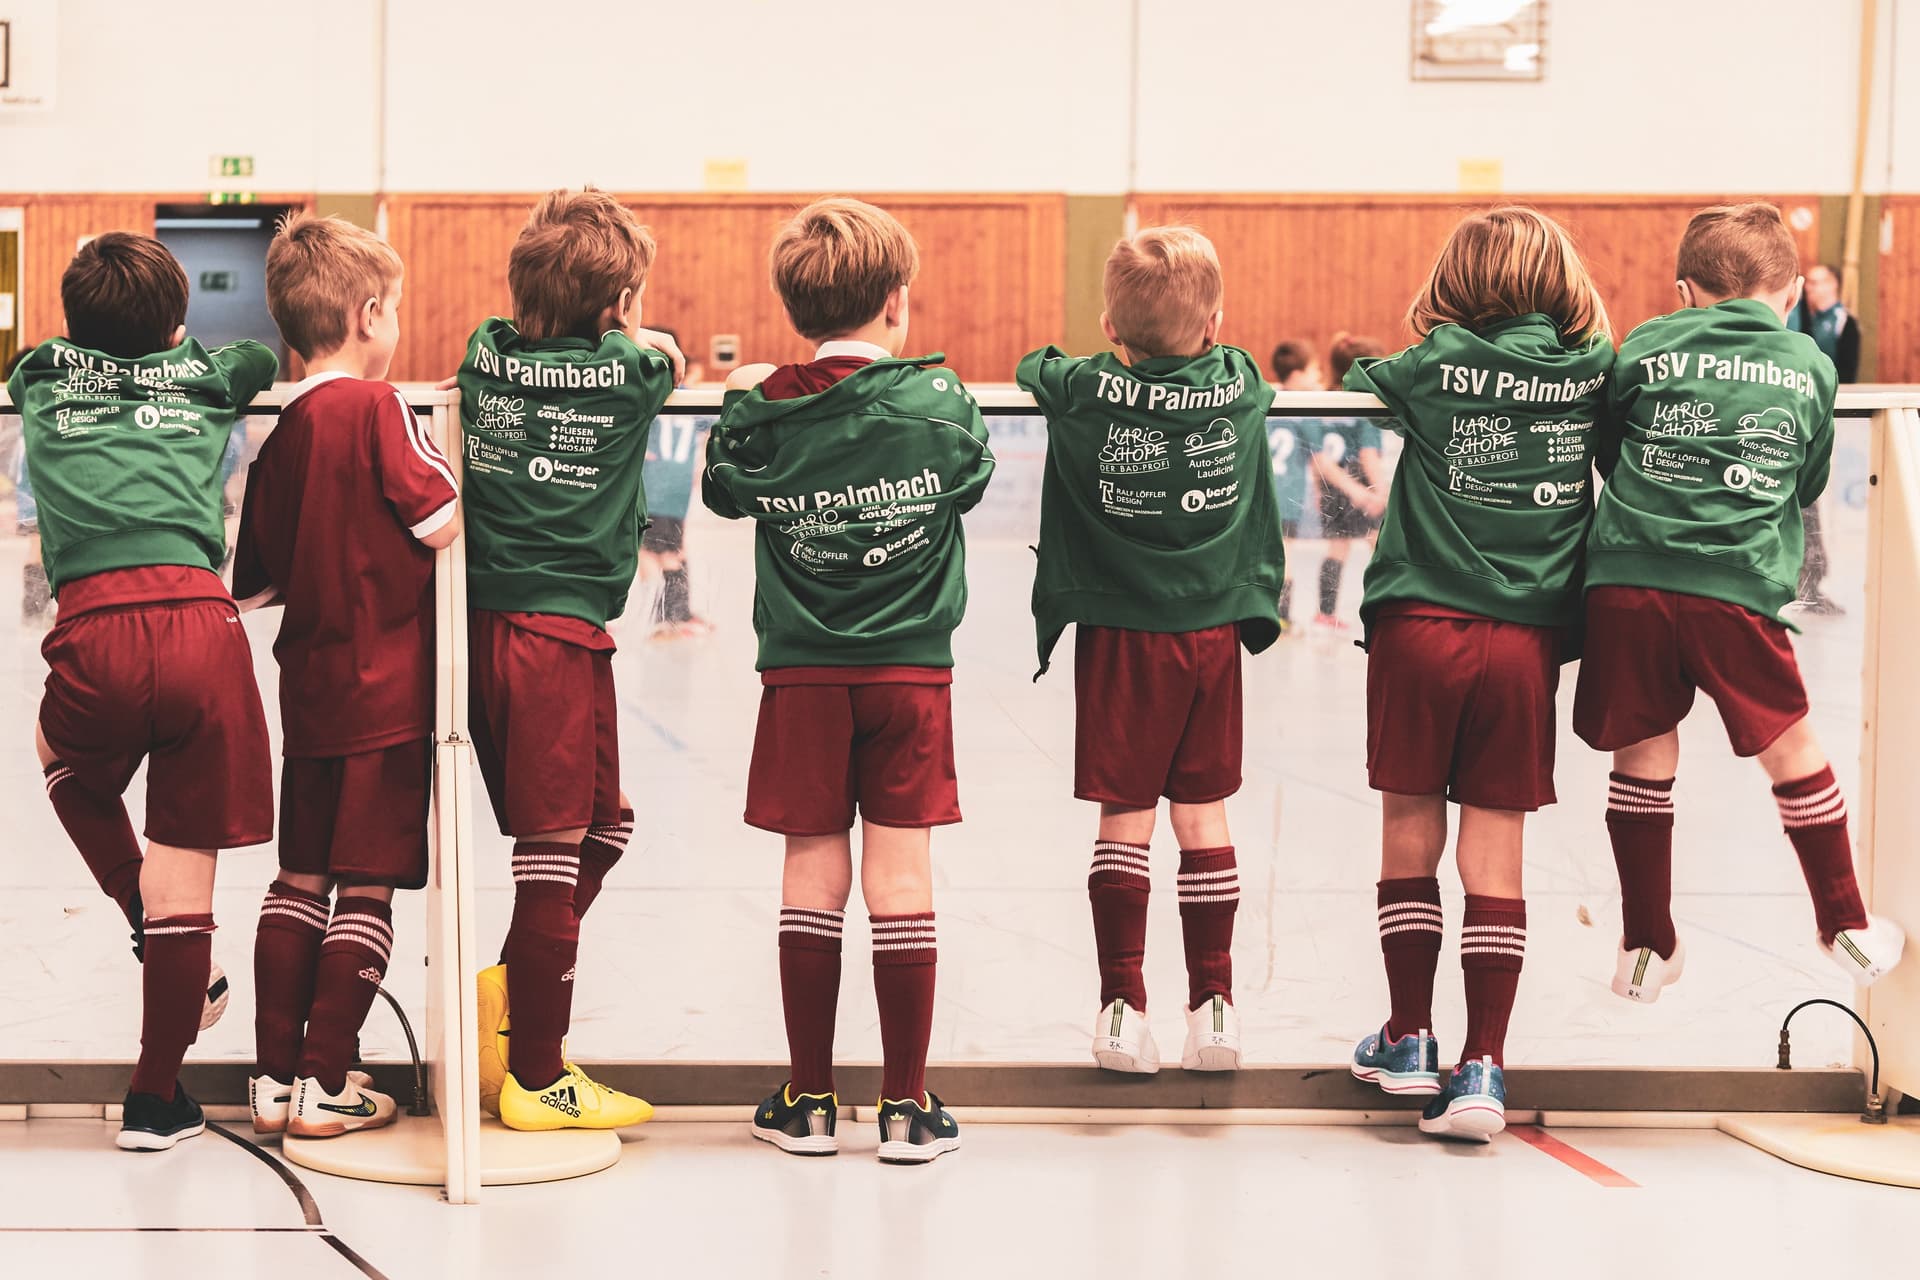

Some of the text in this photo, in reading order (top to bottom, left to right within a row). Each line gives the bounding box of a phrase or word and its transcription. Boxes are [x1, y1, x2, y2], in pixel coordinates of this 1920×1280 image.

[505, 357, 626, 389] Palmbach
[1639, 352, 1815, 399] TSV Palmbach
[1096, 369, 1245, 411] TSV Palmbach
[1439, 363, 1606, 403] TSV Palmbach
[159, 405, 202, 421] berger
[559, 425, 594, 437] FLIESEN
[558, 434, 598, 446] PLATTEN
[1737, 436, 1790, 460] Auto-Service
[557, 443, 595, 454] MOSAIK
[1657, 449, 1677, 460] RALF
[1467, 450, 1519, 464] BAD-PROFI
[1655, 457, 1685, 470] DESIGN
[553, 459, 600, 477] berger
[1099, 459, 1170, 473] DER BAD-PROFI
[1116, 487, 1167, 499] RALF LÖFFLER
[1465, 482, 1493, 493] DESIGN
[1116, 495, 1143, 506] DESIGN
[858, 500, 937, 520] GOLDSCHMIDT
[885, 525, 926, 552] berger
[297, 1081, 307, 1117] TEMPO
[540, 1095, 582, 1119] adidas
